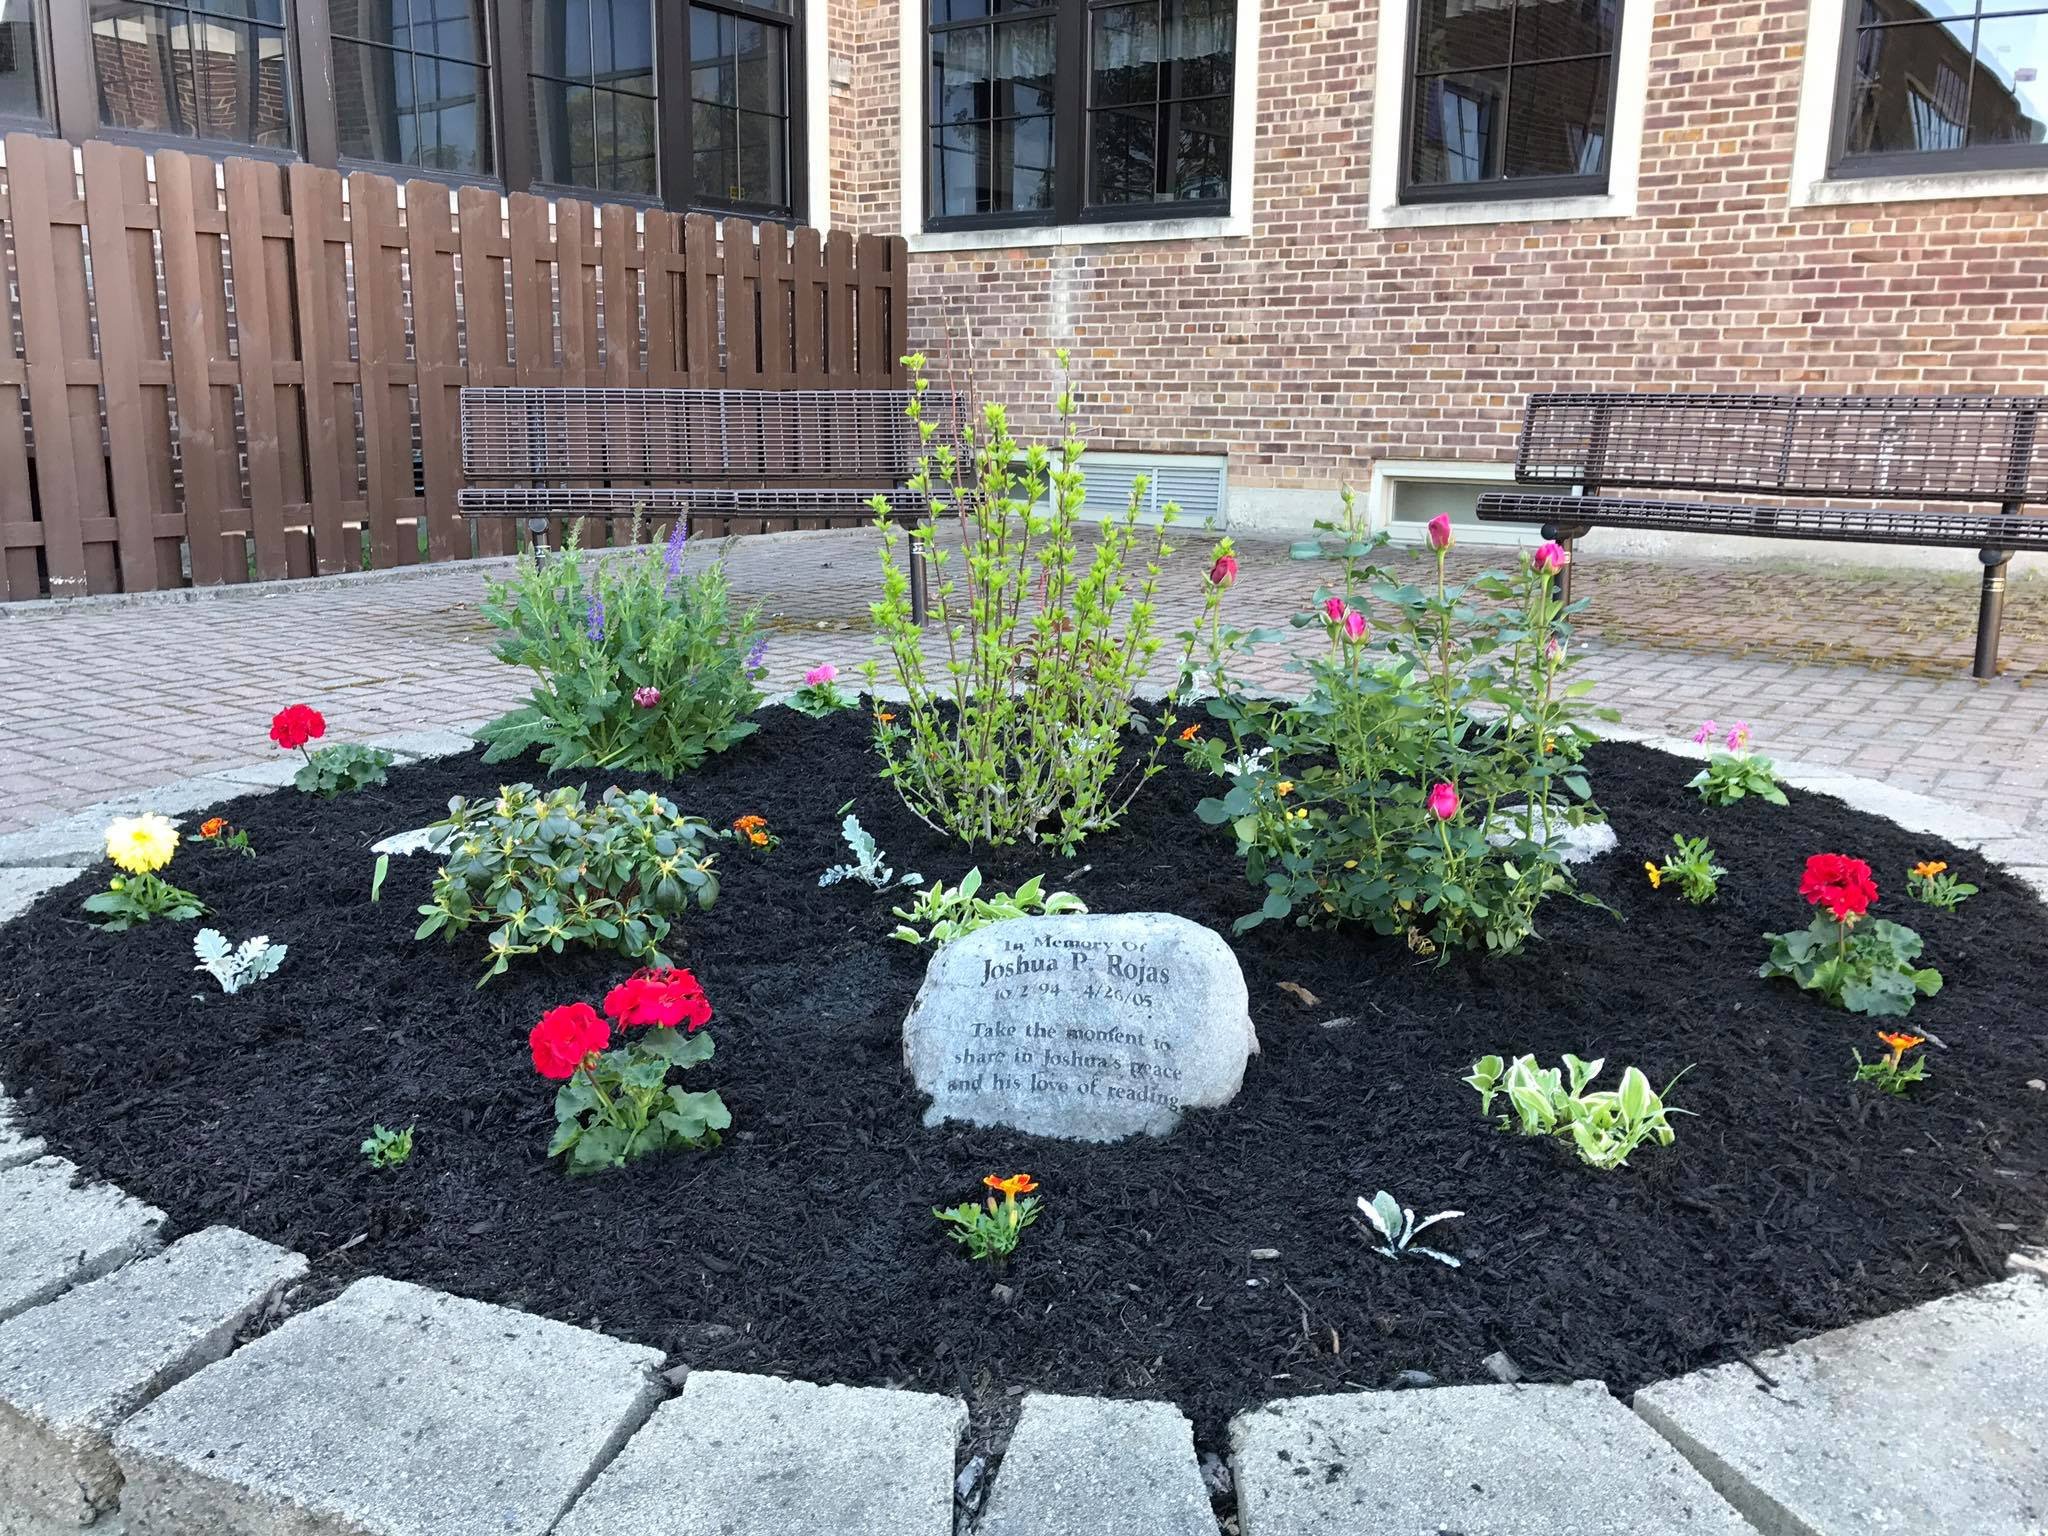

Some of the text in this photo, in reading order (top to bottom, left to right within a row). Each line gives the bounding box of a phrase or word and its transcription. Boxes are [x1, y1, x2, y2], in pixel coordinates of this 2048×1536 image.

[1003, 935, 1147, 952] In Memory Of
[980, 952, 1170, 987] Joshua P. Rojas
[1084, 984, 1153, 1007] 4/26/05
[971, 1021, 1172, 1051] Take the moment to
[955, 1048, 1182, 1080] share in Joshua's peace
[948, 1074, 983, 1093] and
[992, 1073, 1020, 1090] his
[1031, 1073, 1068, 1093] love
[1077, 1073, 1099, 1096] of
